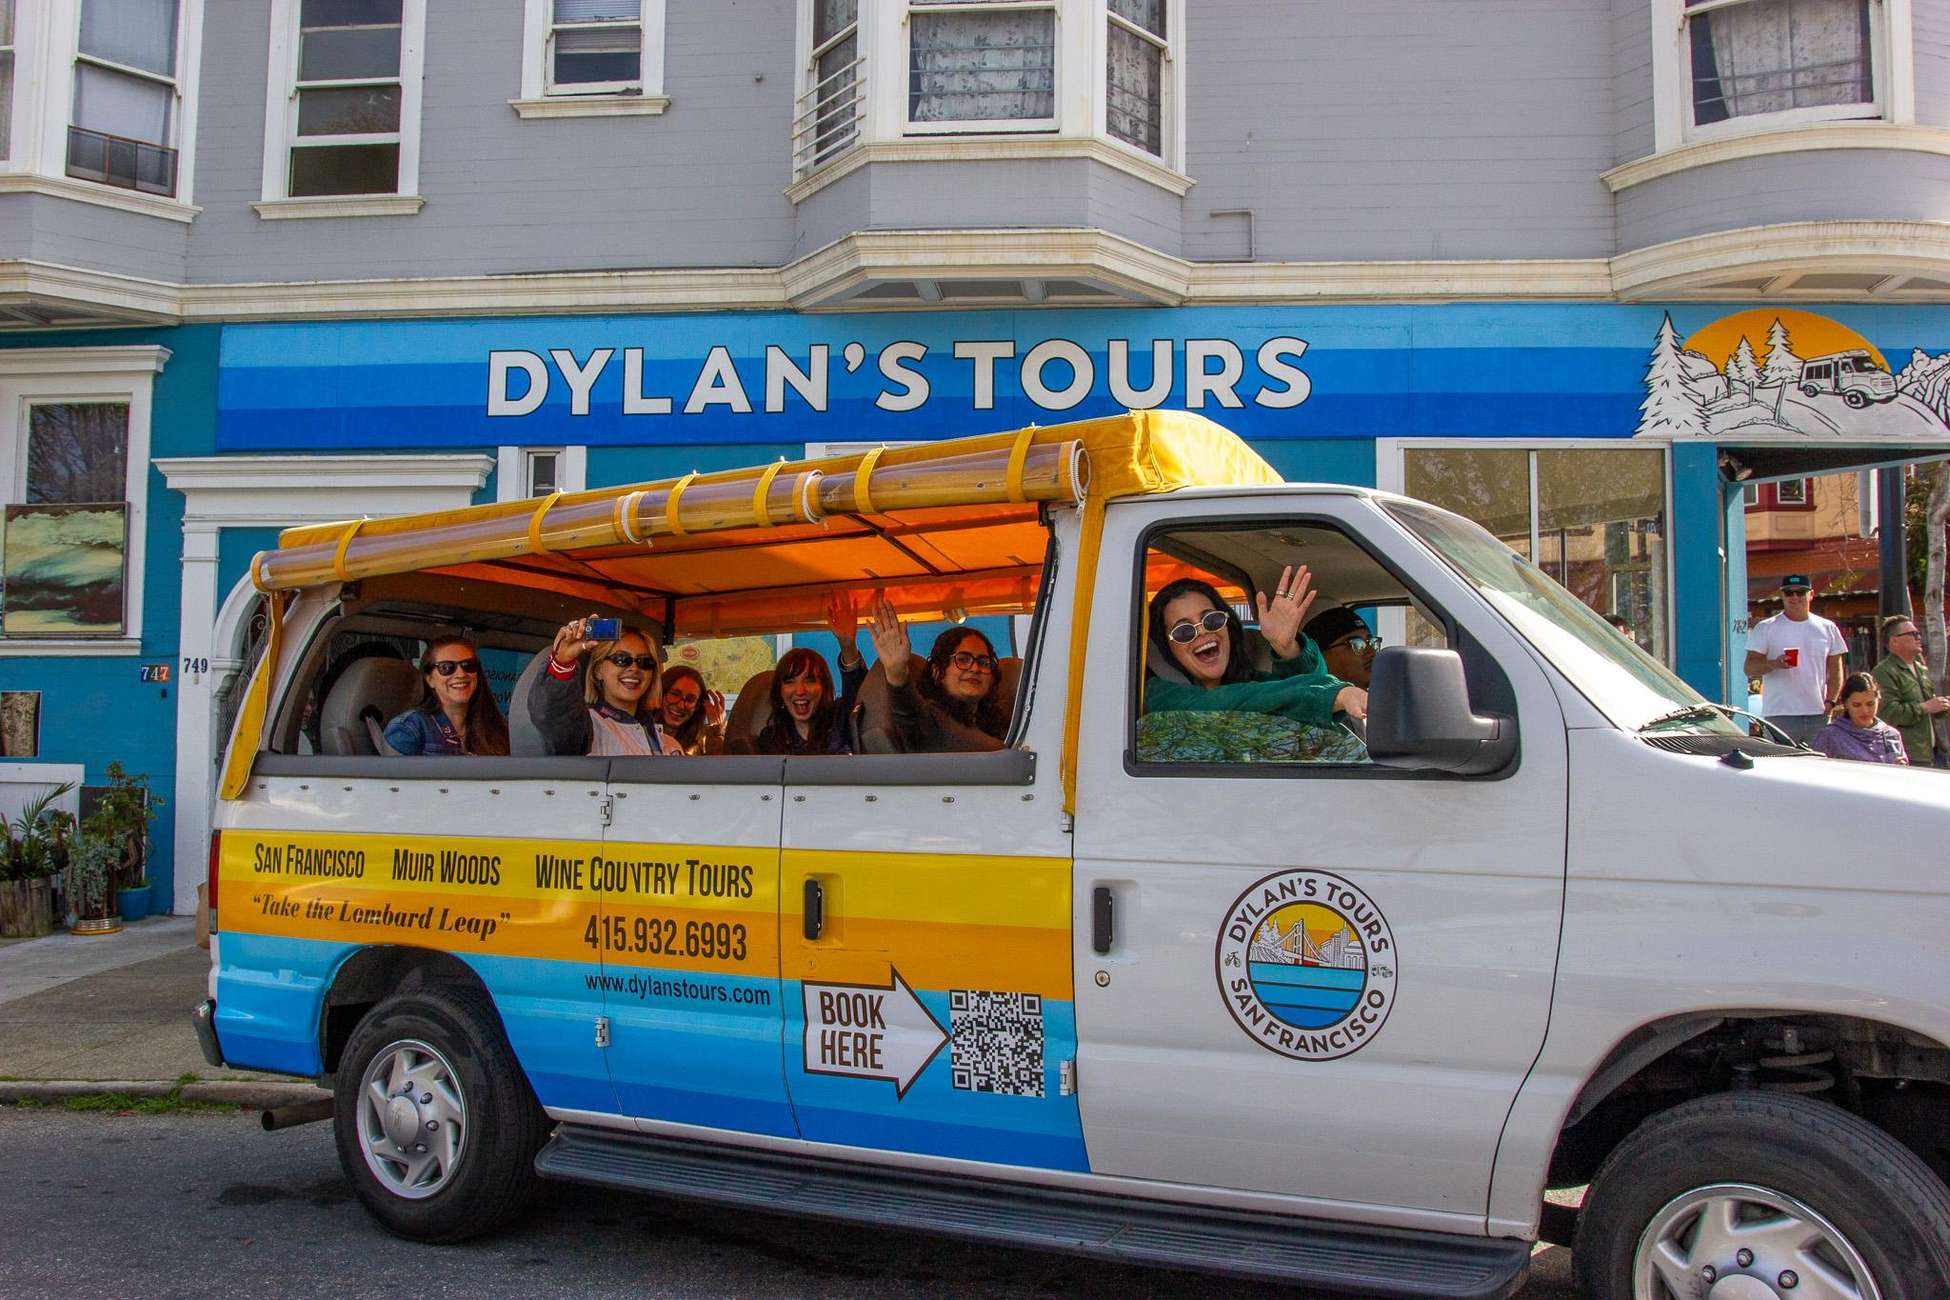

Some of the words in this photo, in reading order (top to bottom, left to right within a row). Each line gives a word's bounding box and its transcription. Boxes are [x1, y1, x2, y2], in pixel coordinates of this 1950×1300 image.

[486, 341, 931, 417] DYLAN'S
[952, 336, 1314, 411] TOURS
[141, 666, 169, 681] 747
[184, 658, 208, 673] 749
[254, 843, 283, 874] SAN
[286, 844, 365, 879] FRANCISCO
[392, 848, 435, 882] MUIR
[440, 850, 501, 886] WOODS
[536, 854, 584, 890] WINE
[686, 859, 754, 898] TOURS
[305, 898, 335, 921] the
[1228, 878, 1317, 944] DYLAN'S
[1326, 882, 1389, 953] TOURS
[584, 914, 747, 961] 415.932.6993
[585, 973, 771, 1005] www.dylanstours.com
[819, 991, 887, 1030] BOOK
[1231, 978, 1266, 1026] SAN
[1262, 989, 1385, 1053] FRANCISCO
[820, 1029, 884, 1070] HERE
